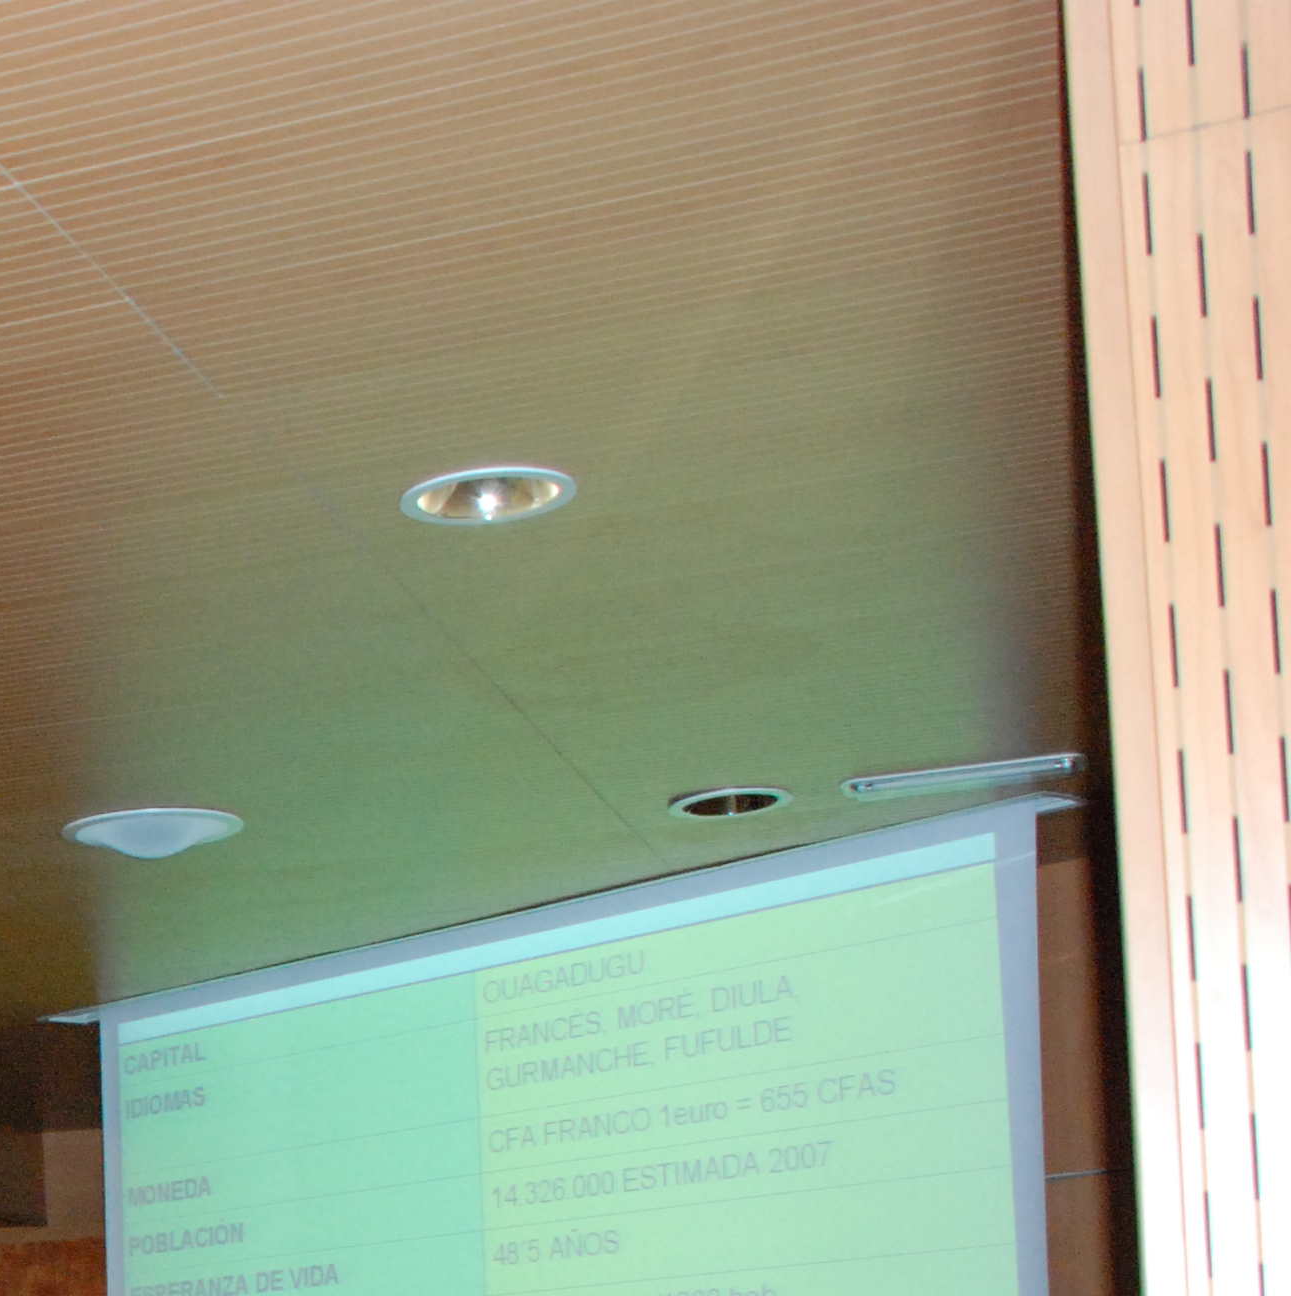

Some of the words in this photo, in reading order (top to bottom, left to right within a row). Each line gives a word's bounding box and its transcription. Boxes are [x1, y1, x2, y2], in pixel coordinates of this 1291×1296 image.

[482, 950, 645, 1004] OUAGADUGU
[664, 1016, 793, 1061] FUFULDE
[124, 1042, 207, 1075] CAPITAL
[125, 1086, 207, 1119] IDIOMAS
[488, 1125, 536, 1153] CFA
[543, 1107, 651, 1146] FRANCO
[660, 1101, 728, 1128] 1euro
[760, 1082, 808, 1114] 655
[817, 1069, 896, 1103] CFAS
[127, 1176, 212, 1207] MONEDA
[490, 1171, 615, 1209] 14.326.000
[622, 1152, 760, 1193] ESTIMADA
[768, 1140, 833, 1174] 2007
[128, 1218, 244, 1257] POBLACIÓN
[549, 1228, 620, 1261] AÑOS
[256, 1270, 284, 1293] DE
[289, 1263, 339, 1289] VIDA
